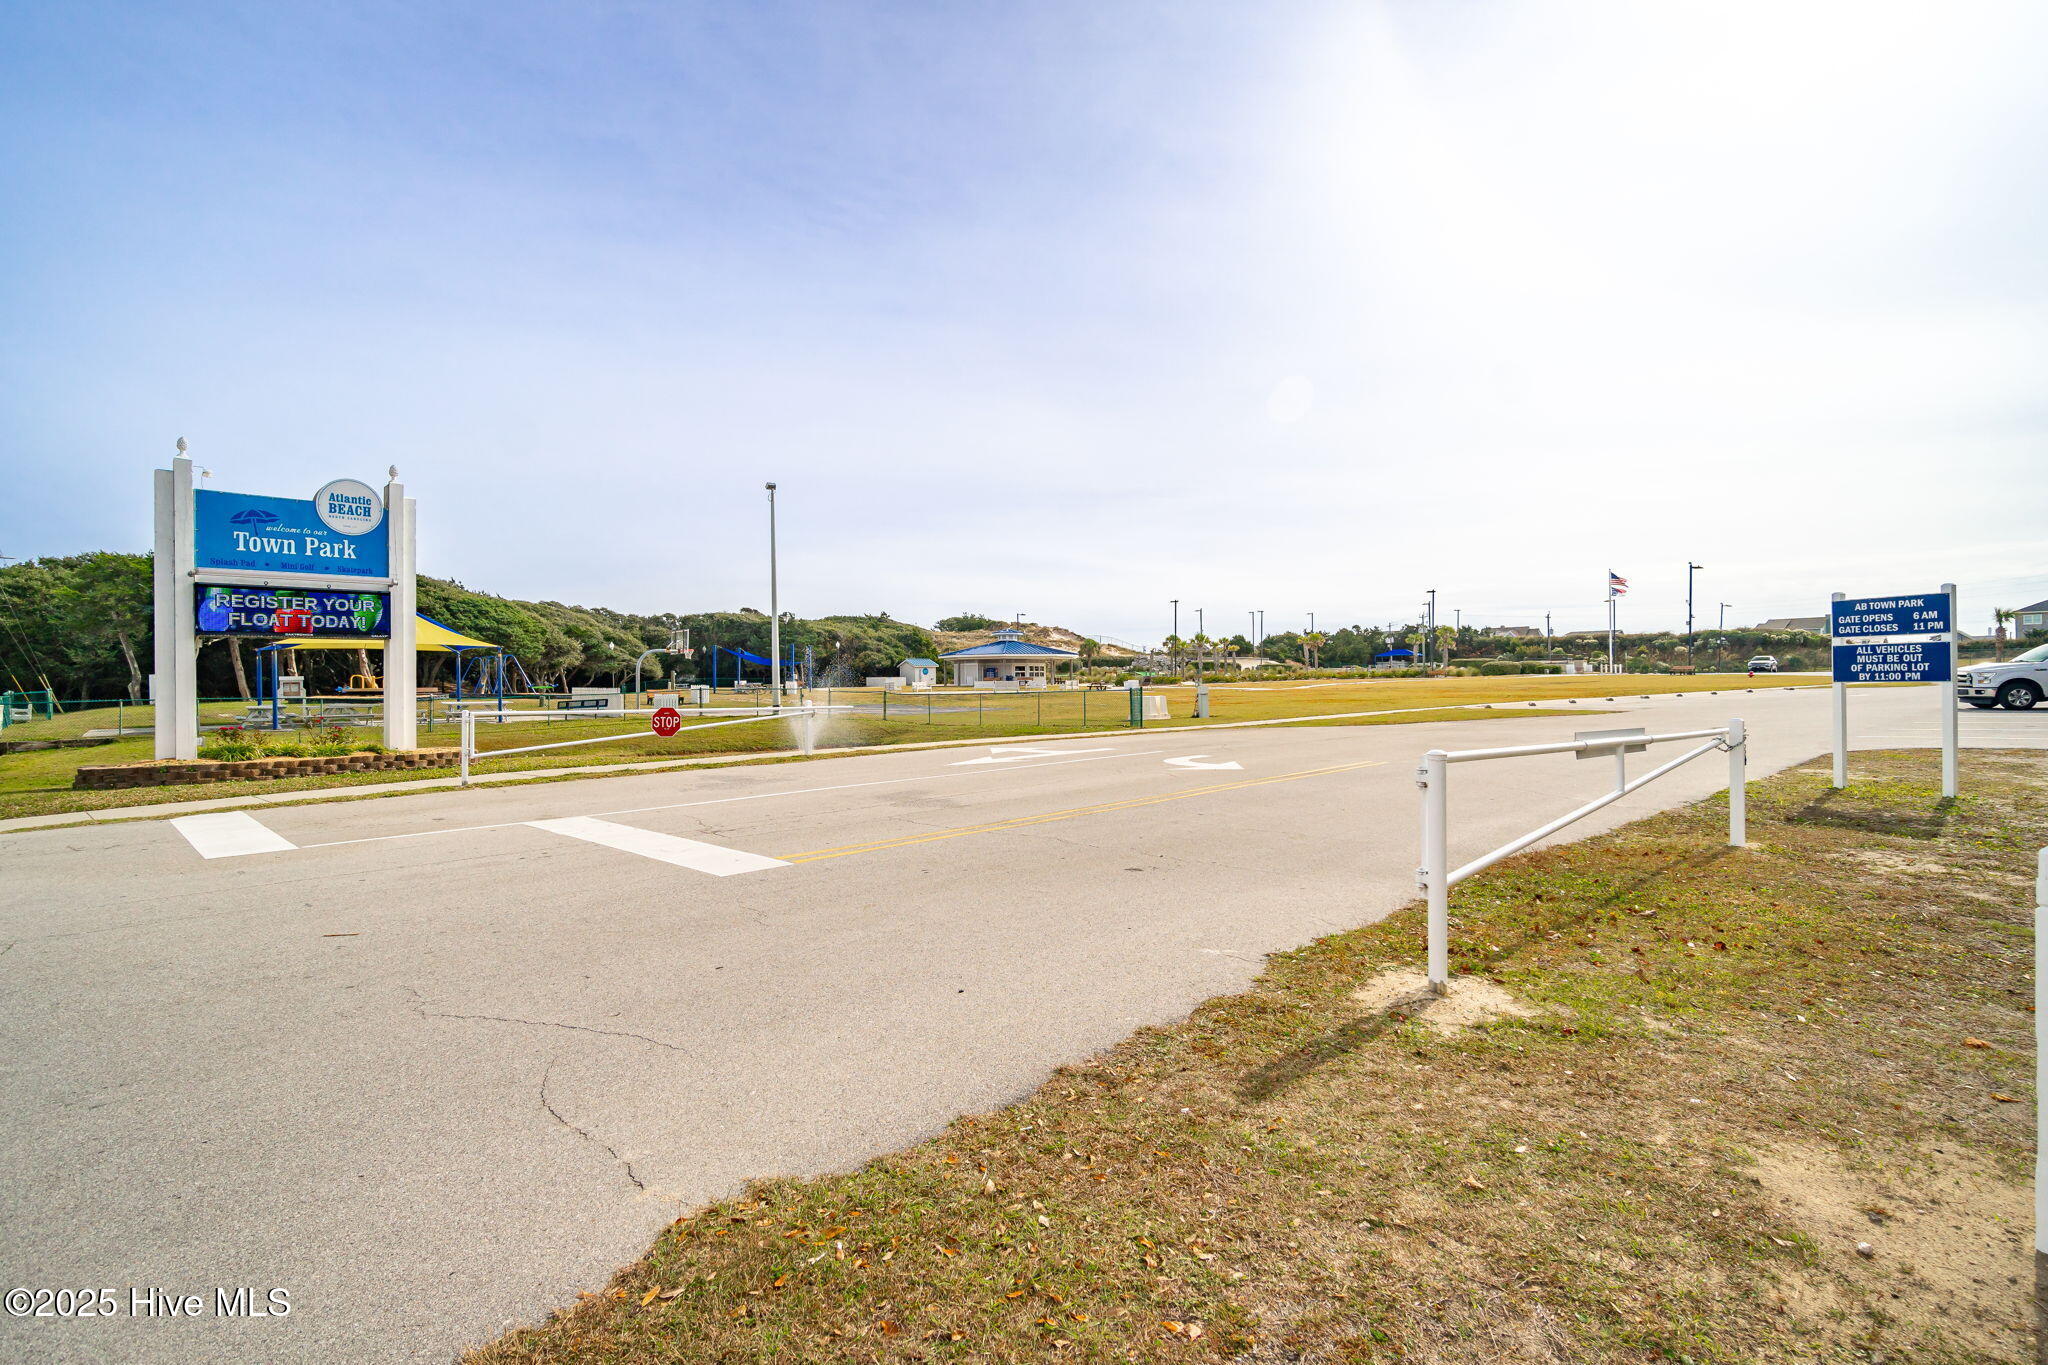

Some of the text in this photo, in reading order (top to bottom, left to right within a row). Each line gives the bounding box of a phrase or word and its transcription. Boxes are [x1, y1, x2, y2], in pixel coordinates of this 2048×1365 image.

[328, 492, 372, 506] Atlantic
[328, 502, 372, 518] BEACH
[266, 524, 300, 534] welcome
[234, 531, 357, 560] Town Park
[209, 558, 373, 575] Splash Pad Mini Golf Skatepark
[216, 594, 376, 612] REGISTER YOUR
[1854, 599, 1924, 611] AB TOWN PARK
[228, 612, 367, 629] FLOAT TODAY!
[1838, 610, 1938, 624] GATE OPENS 6 AM
[1838, 621, 1944, 634] GATE CLOSES 11 PM
[1876, 645, 1922, 653] VEHICLES
[1856, 655, 1883, 663] MUST
[1903, 654, 1923, 662] OUT
[1866, 663, 1908, 671] PARKING
[653, 716, 680, 728] STOP
